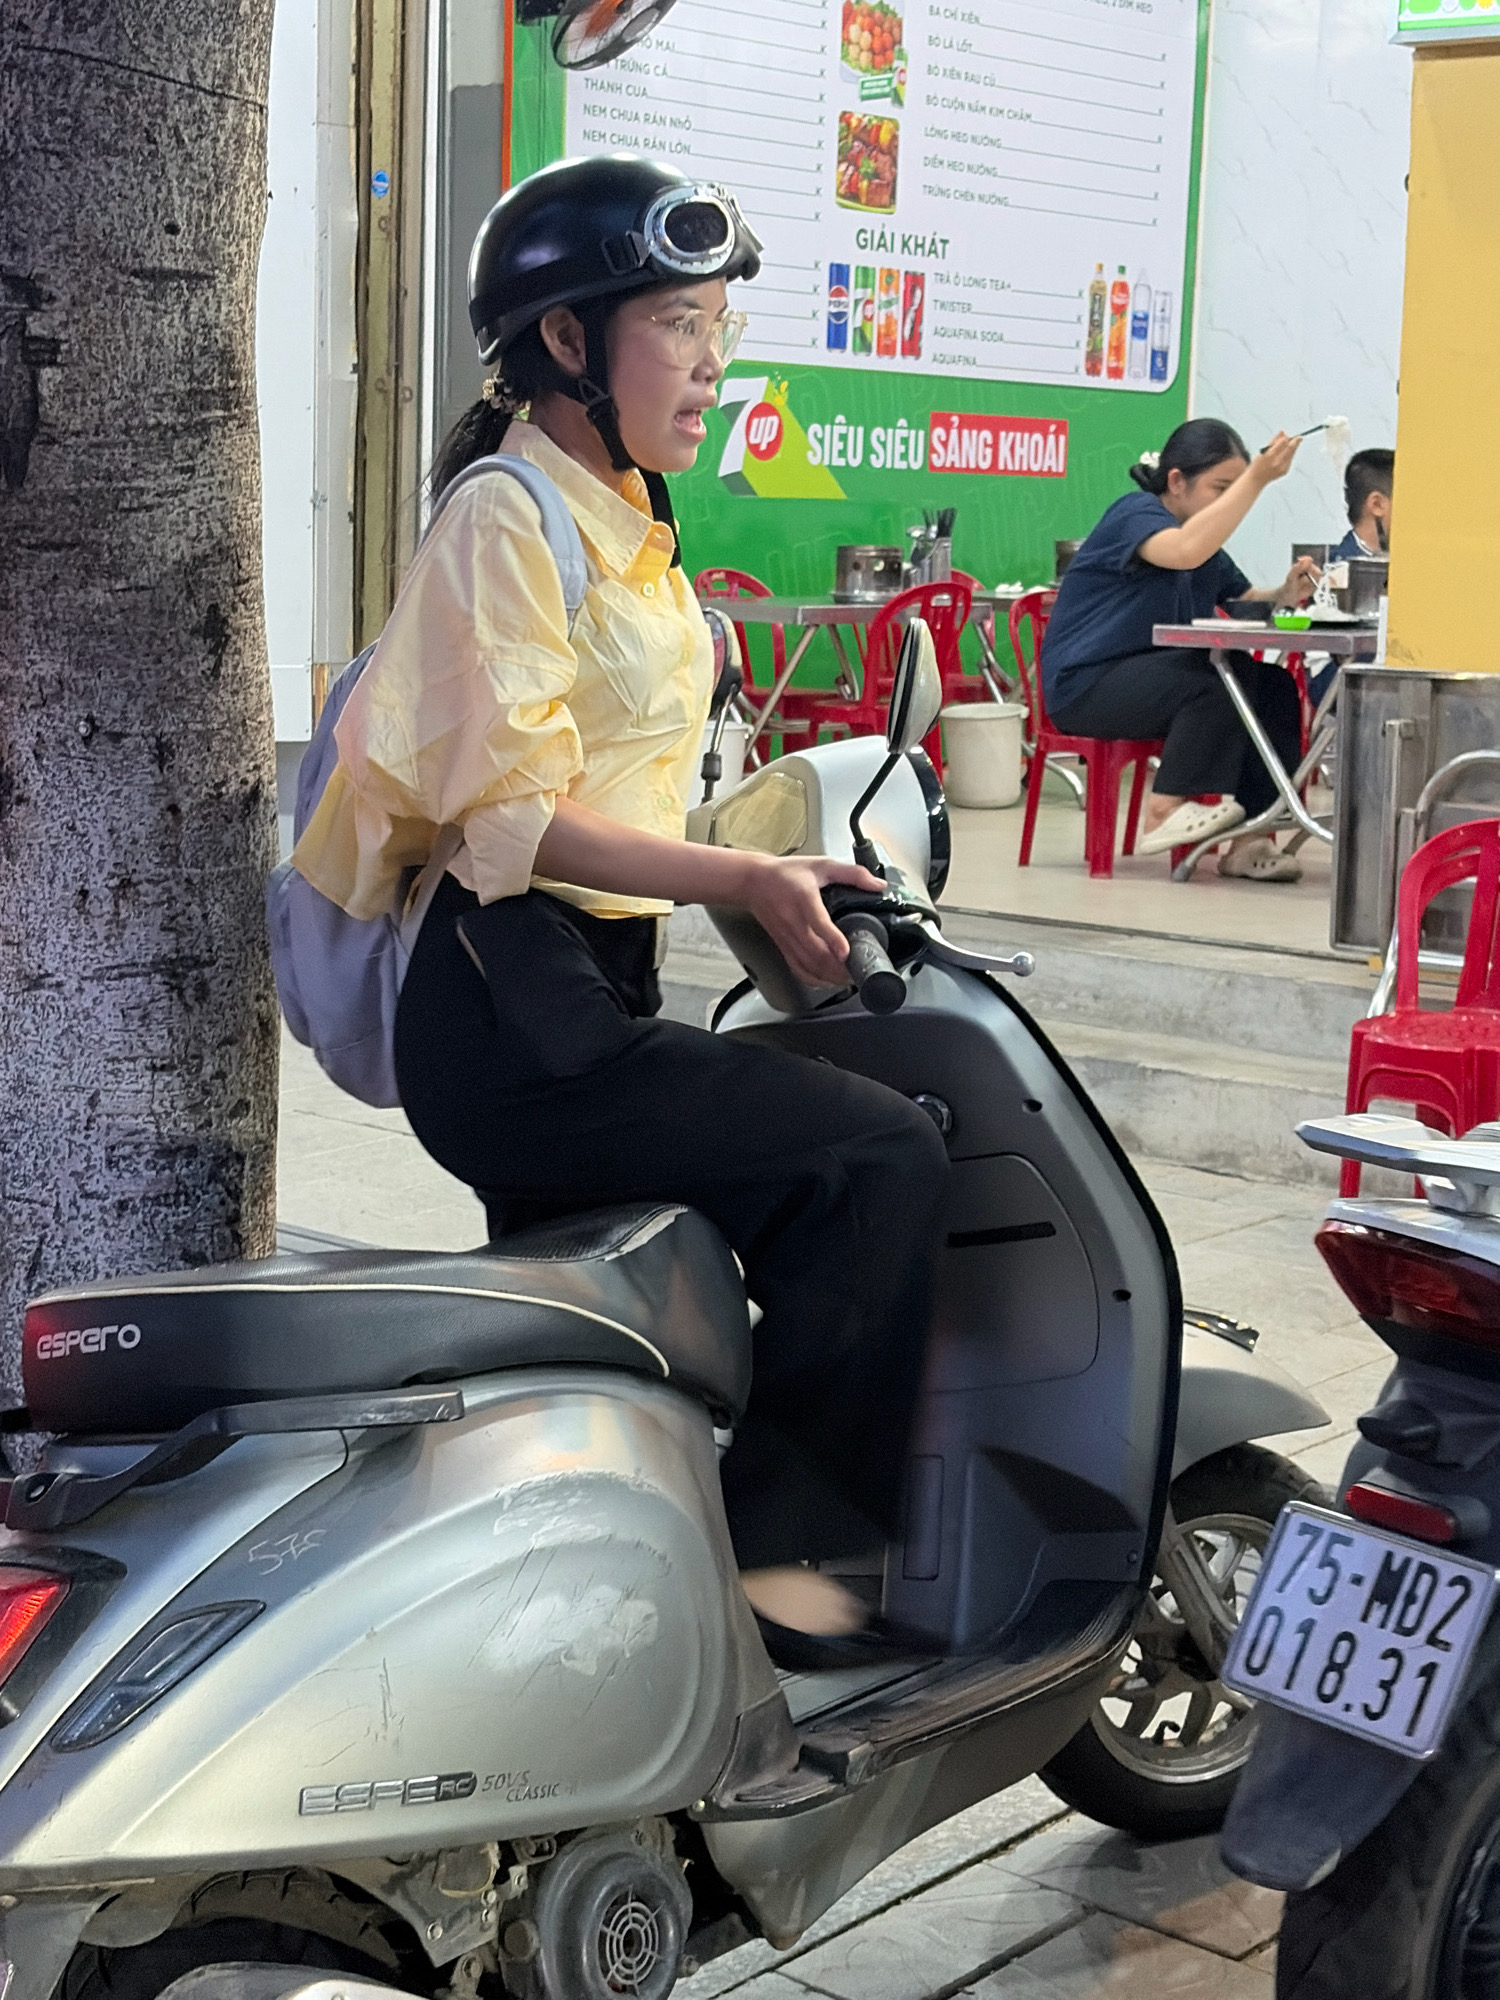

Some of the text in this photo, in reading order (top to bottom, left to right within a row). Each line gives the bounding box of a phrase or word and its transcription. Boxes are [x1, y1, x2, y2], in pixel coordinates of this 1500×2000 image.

[656, 39, 675, 53] MAI
[584, 78, 622, 96] THANH
[625, 84, 648, 98] CUA
[583, 103, 607, 119] NEM
[610, 107, 640, 122] CHUA
[643, 110, 667, 127] RÁN
[989, 106, 1005, 118] KIM
[582, 129, 606, 144] NEM
[609, 132, 640, 148] CHUA
[643, 136, 666, 152] RÁN
[950, 131, 969, 143] HEO
[946, 160, 965, 172] HEO
[856, 222, 950, 259] GIẢI KHÁT
[963, 276, 987, 289] LONG
[933, 299, 972, 314] TWISTER
[933, 325, 978, 340] AQUAFINA
[981, 330, 1004, 342] SODA
[932, 353, 977, 366] AQUAFINA
[807, 414, 1066, 473] SIÊU SIÊU SẢNG KHOÁI
[1245, 1605, 1440, 1737] 018.31
[482, 1770, 531, 1792] 50VS
[506, 1782, 560, 1802] CLASSIC
